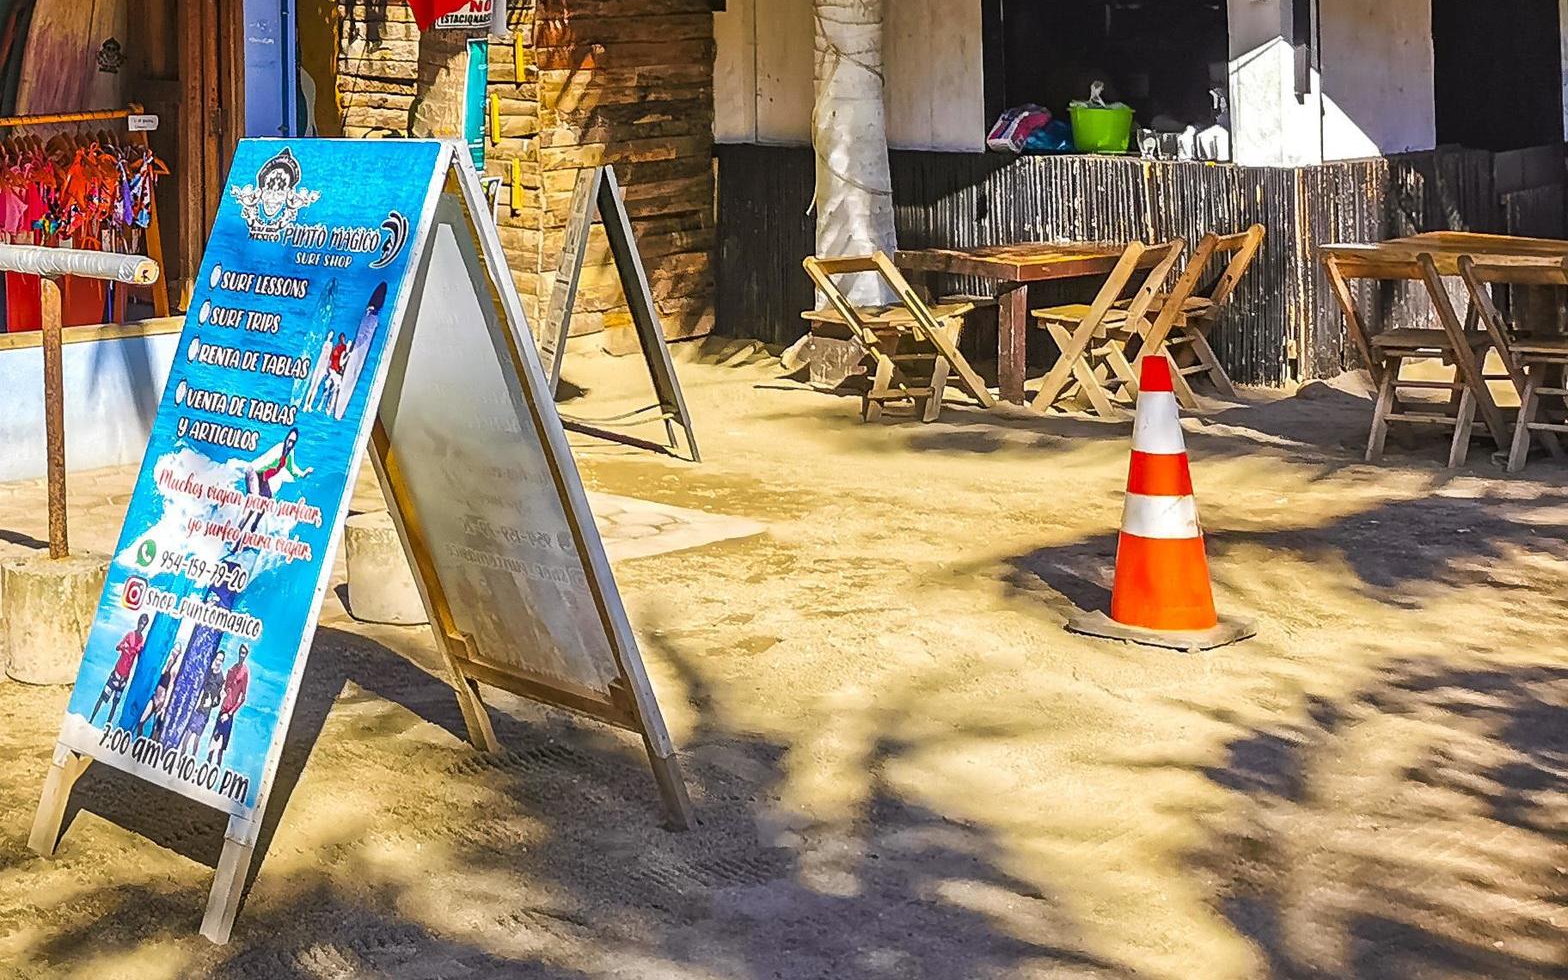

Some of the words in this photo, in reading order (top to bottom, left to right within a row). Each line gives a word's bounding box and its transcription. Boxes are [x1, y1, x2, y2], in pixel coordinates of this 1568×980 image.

[469, 0, 492, 13] NO
[283, 223, 326, 247] PUNTO
[295, 252, 320, 266] SURF
[323, 255, 352, 268] SHOP
[221, 271, 254, 292] SURF
[255, 276, 308, 298] LESSONS
[211, 307, 244, 328] SURF
[246, 311, 281, 333] TRIPS
[199, 344, 240, 368] RENTA
[242, 351, 260, 371] DE
[261, 354, 310, 378] TABLAS
[187, 388, 227, 413] VENTA
[229, 397, 247, 417] DE
[248, 400, 297, 425] TABLAS
[189, 421, 259, 451] ARTICULOS
[159, 469, 203, 499] Muchos
[207, 485, 242, 507] viajan
[243, 493, 274, 514] para
[186, 518, 202, 538] yo
[204, 521, 240, 541] surfeo
[240, 531, 271, 550] para
[160, 550, 247, 590] 954-159-79-20
[99, 724, 131, 755] 7:00
[132, 737, 161, 768] am
[163, 749, 177, 775] a
[178, 757, 219, 790] 10:00
